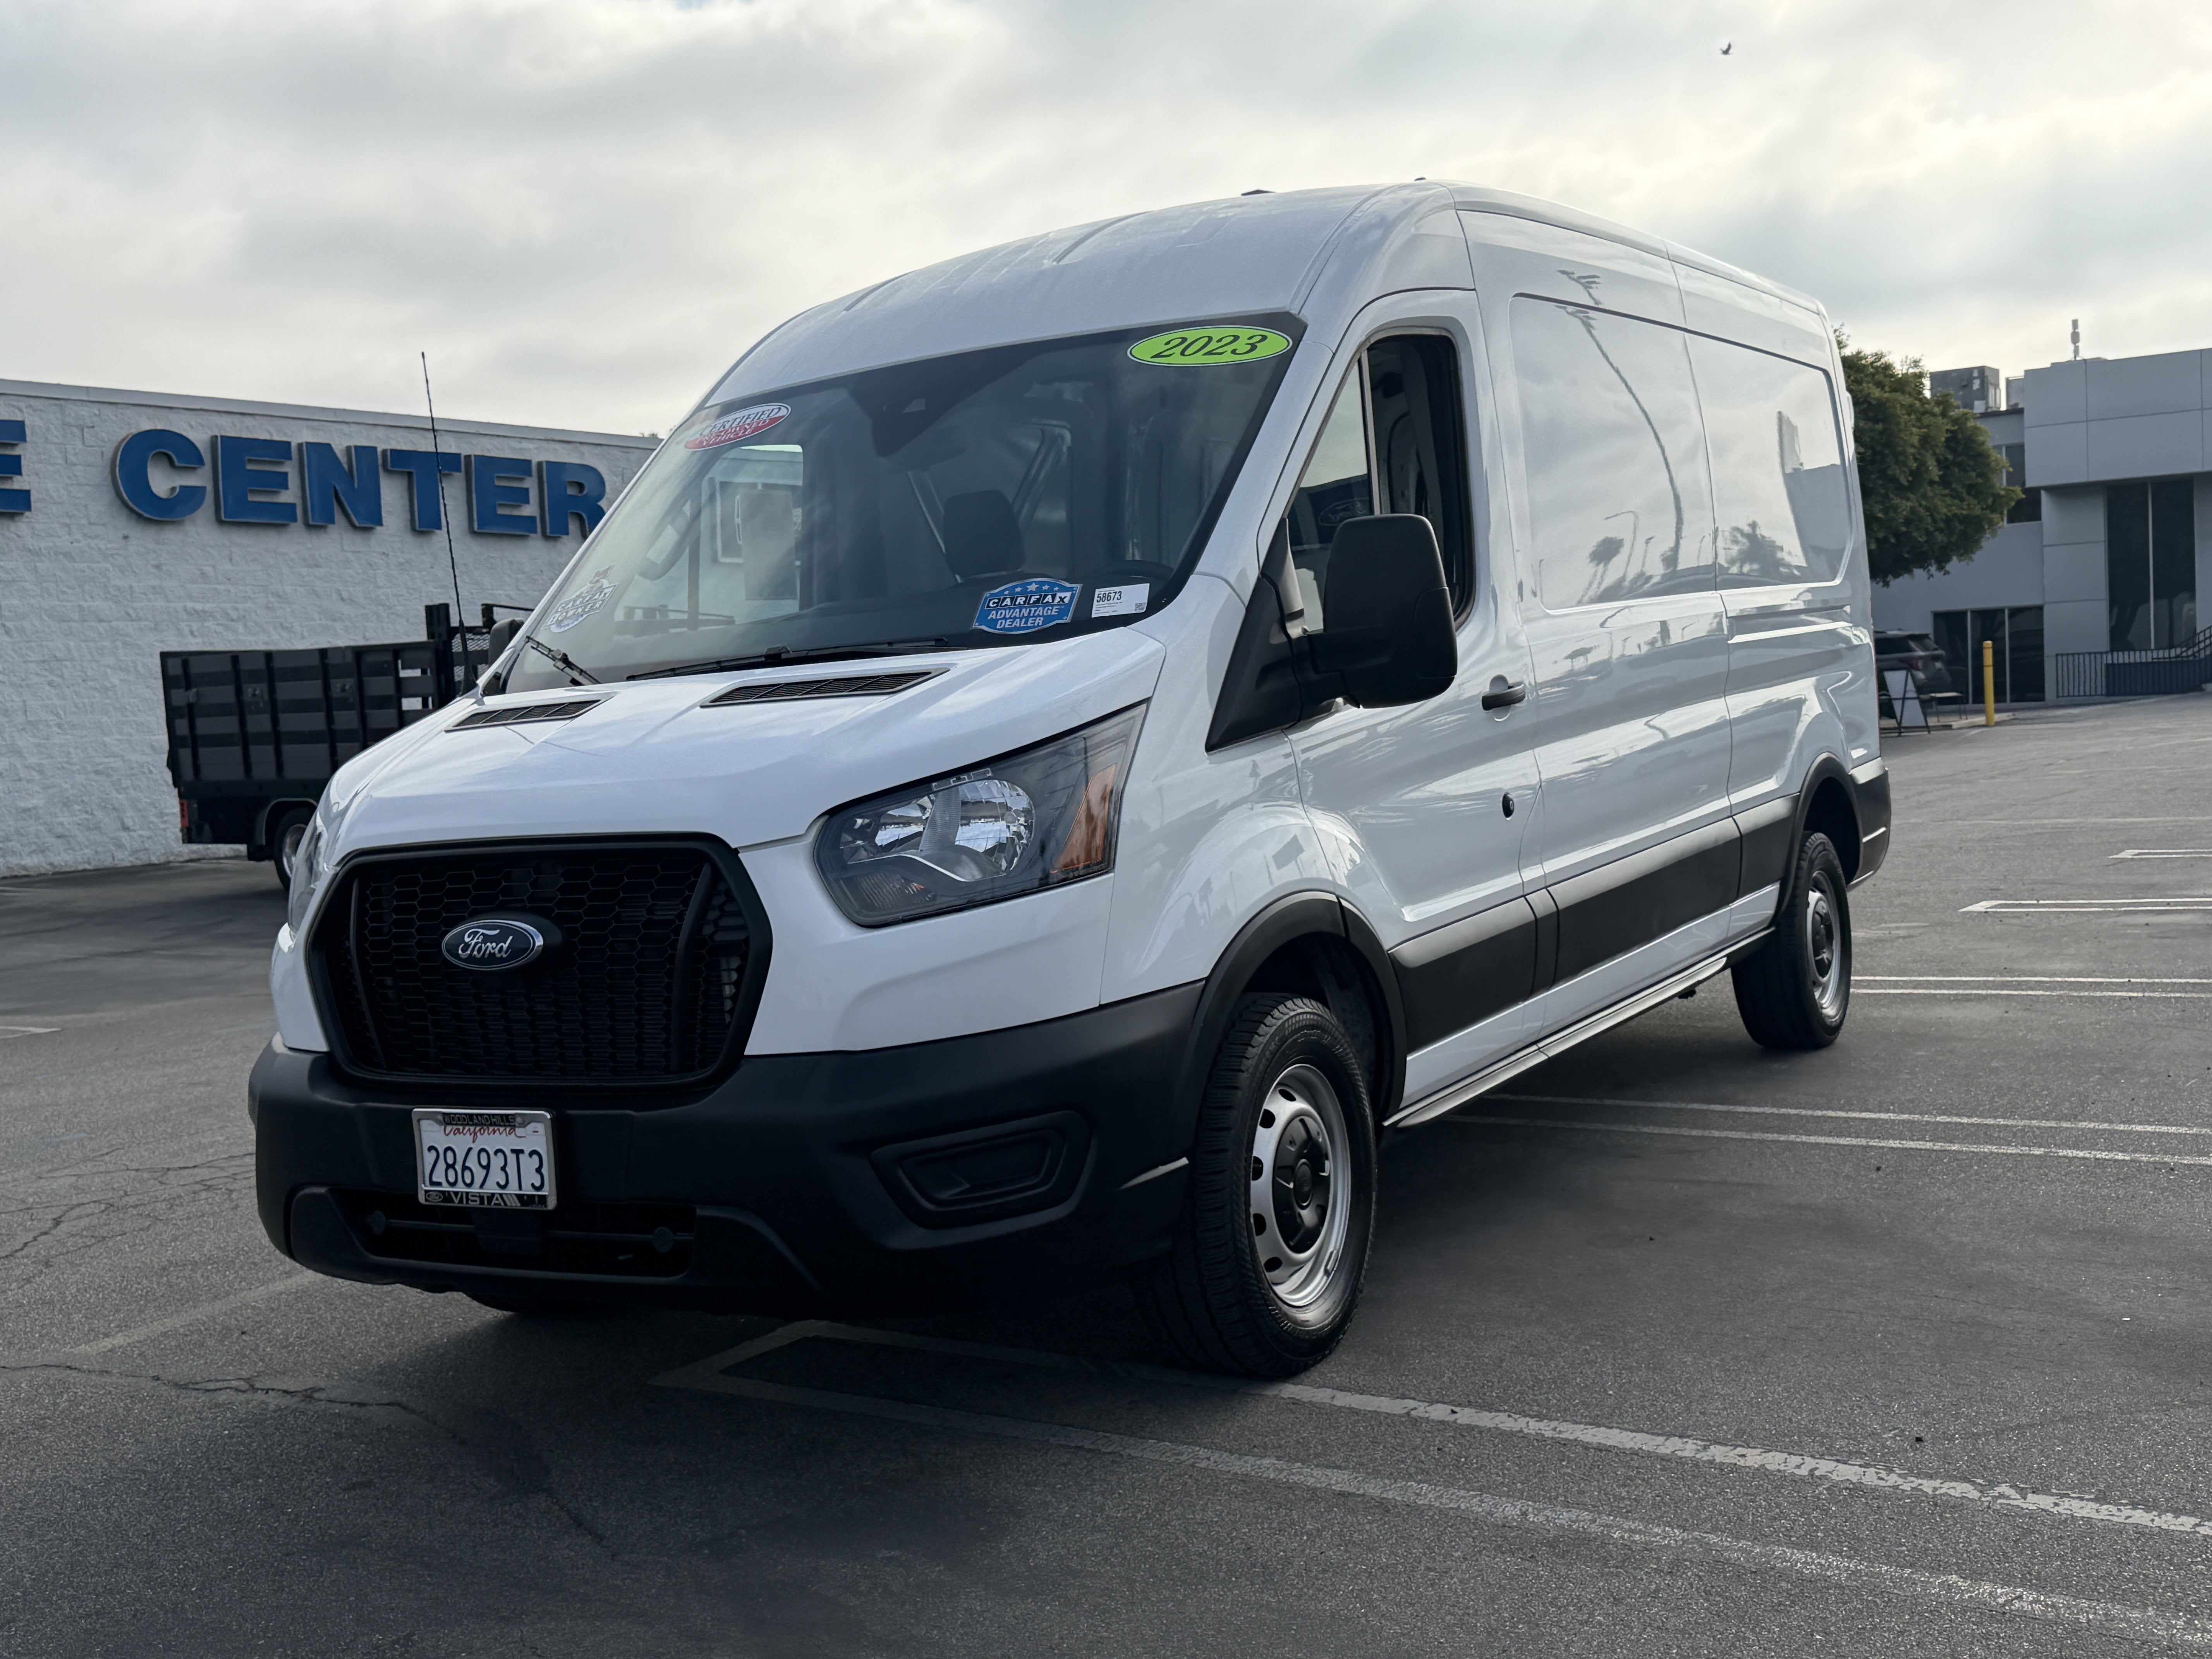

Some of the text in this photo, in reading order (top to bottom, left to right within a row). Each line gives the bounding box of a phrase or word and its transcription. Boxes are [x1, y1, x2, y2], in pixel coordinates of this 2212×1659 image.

[1149, 334, 1268, 359] 2023
[700, 407, 780, 437] CERTIFIED
[703, 427, 755, 446] VEHICLE
[116, 428, 606, 537] CENTER
[988, 594, 1069, 608] CARFAX
[1096, 591, 1122, 603] 58673
[988, 606, 1059, 620] ADVANTAGE
[996, 617, 1044, 629] DEALER
[458, 928, 513, 958] Ford
[443, 1125, 527, 1143] California
[427, 1145, 545, 1191] 28693T3
[449, 1191, 505, 1206] VISTA
